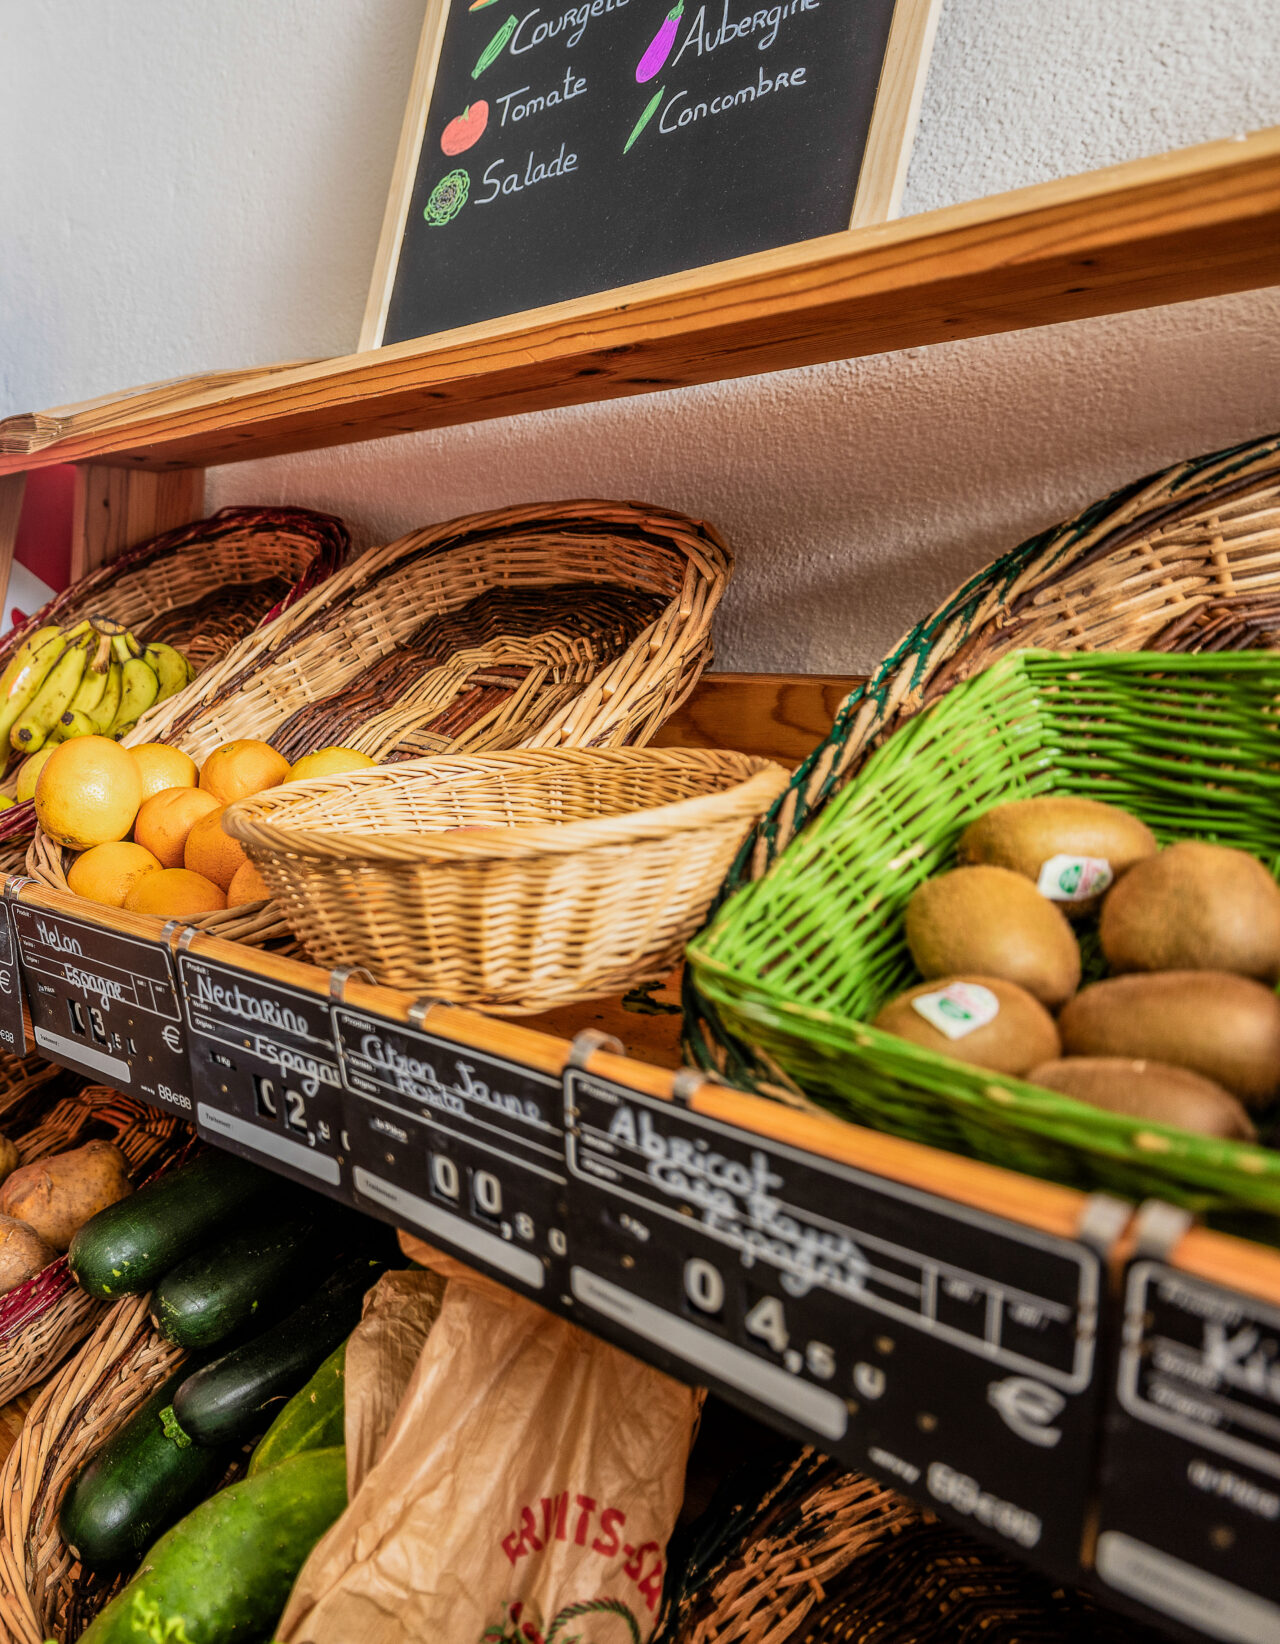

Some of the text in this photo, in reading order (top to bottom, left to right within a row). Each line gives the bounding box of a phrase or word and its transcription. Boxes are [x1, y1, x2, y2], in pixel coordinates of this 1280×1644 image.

[496, 67, 588, 127] Tomate
[659, 66, 807, 134] Concombre
[474, 143, 579, 205] Salade
[37, 920, 83, 957] Melon
[64, 963, 125, 1012] Espagne
[197, 974, 312, 1037] Nectarine
[161, 1025, 183, 1053] €
[361, 1034, 546, 1125] Citron Jaune
[609, 1105, 784, 1197] Abricot
[986, 1376, 1067, 1448] €
